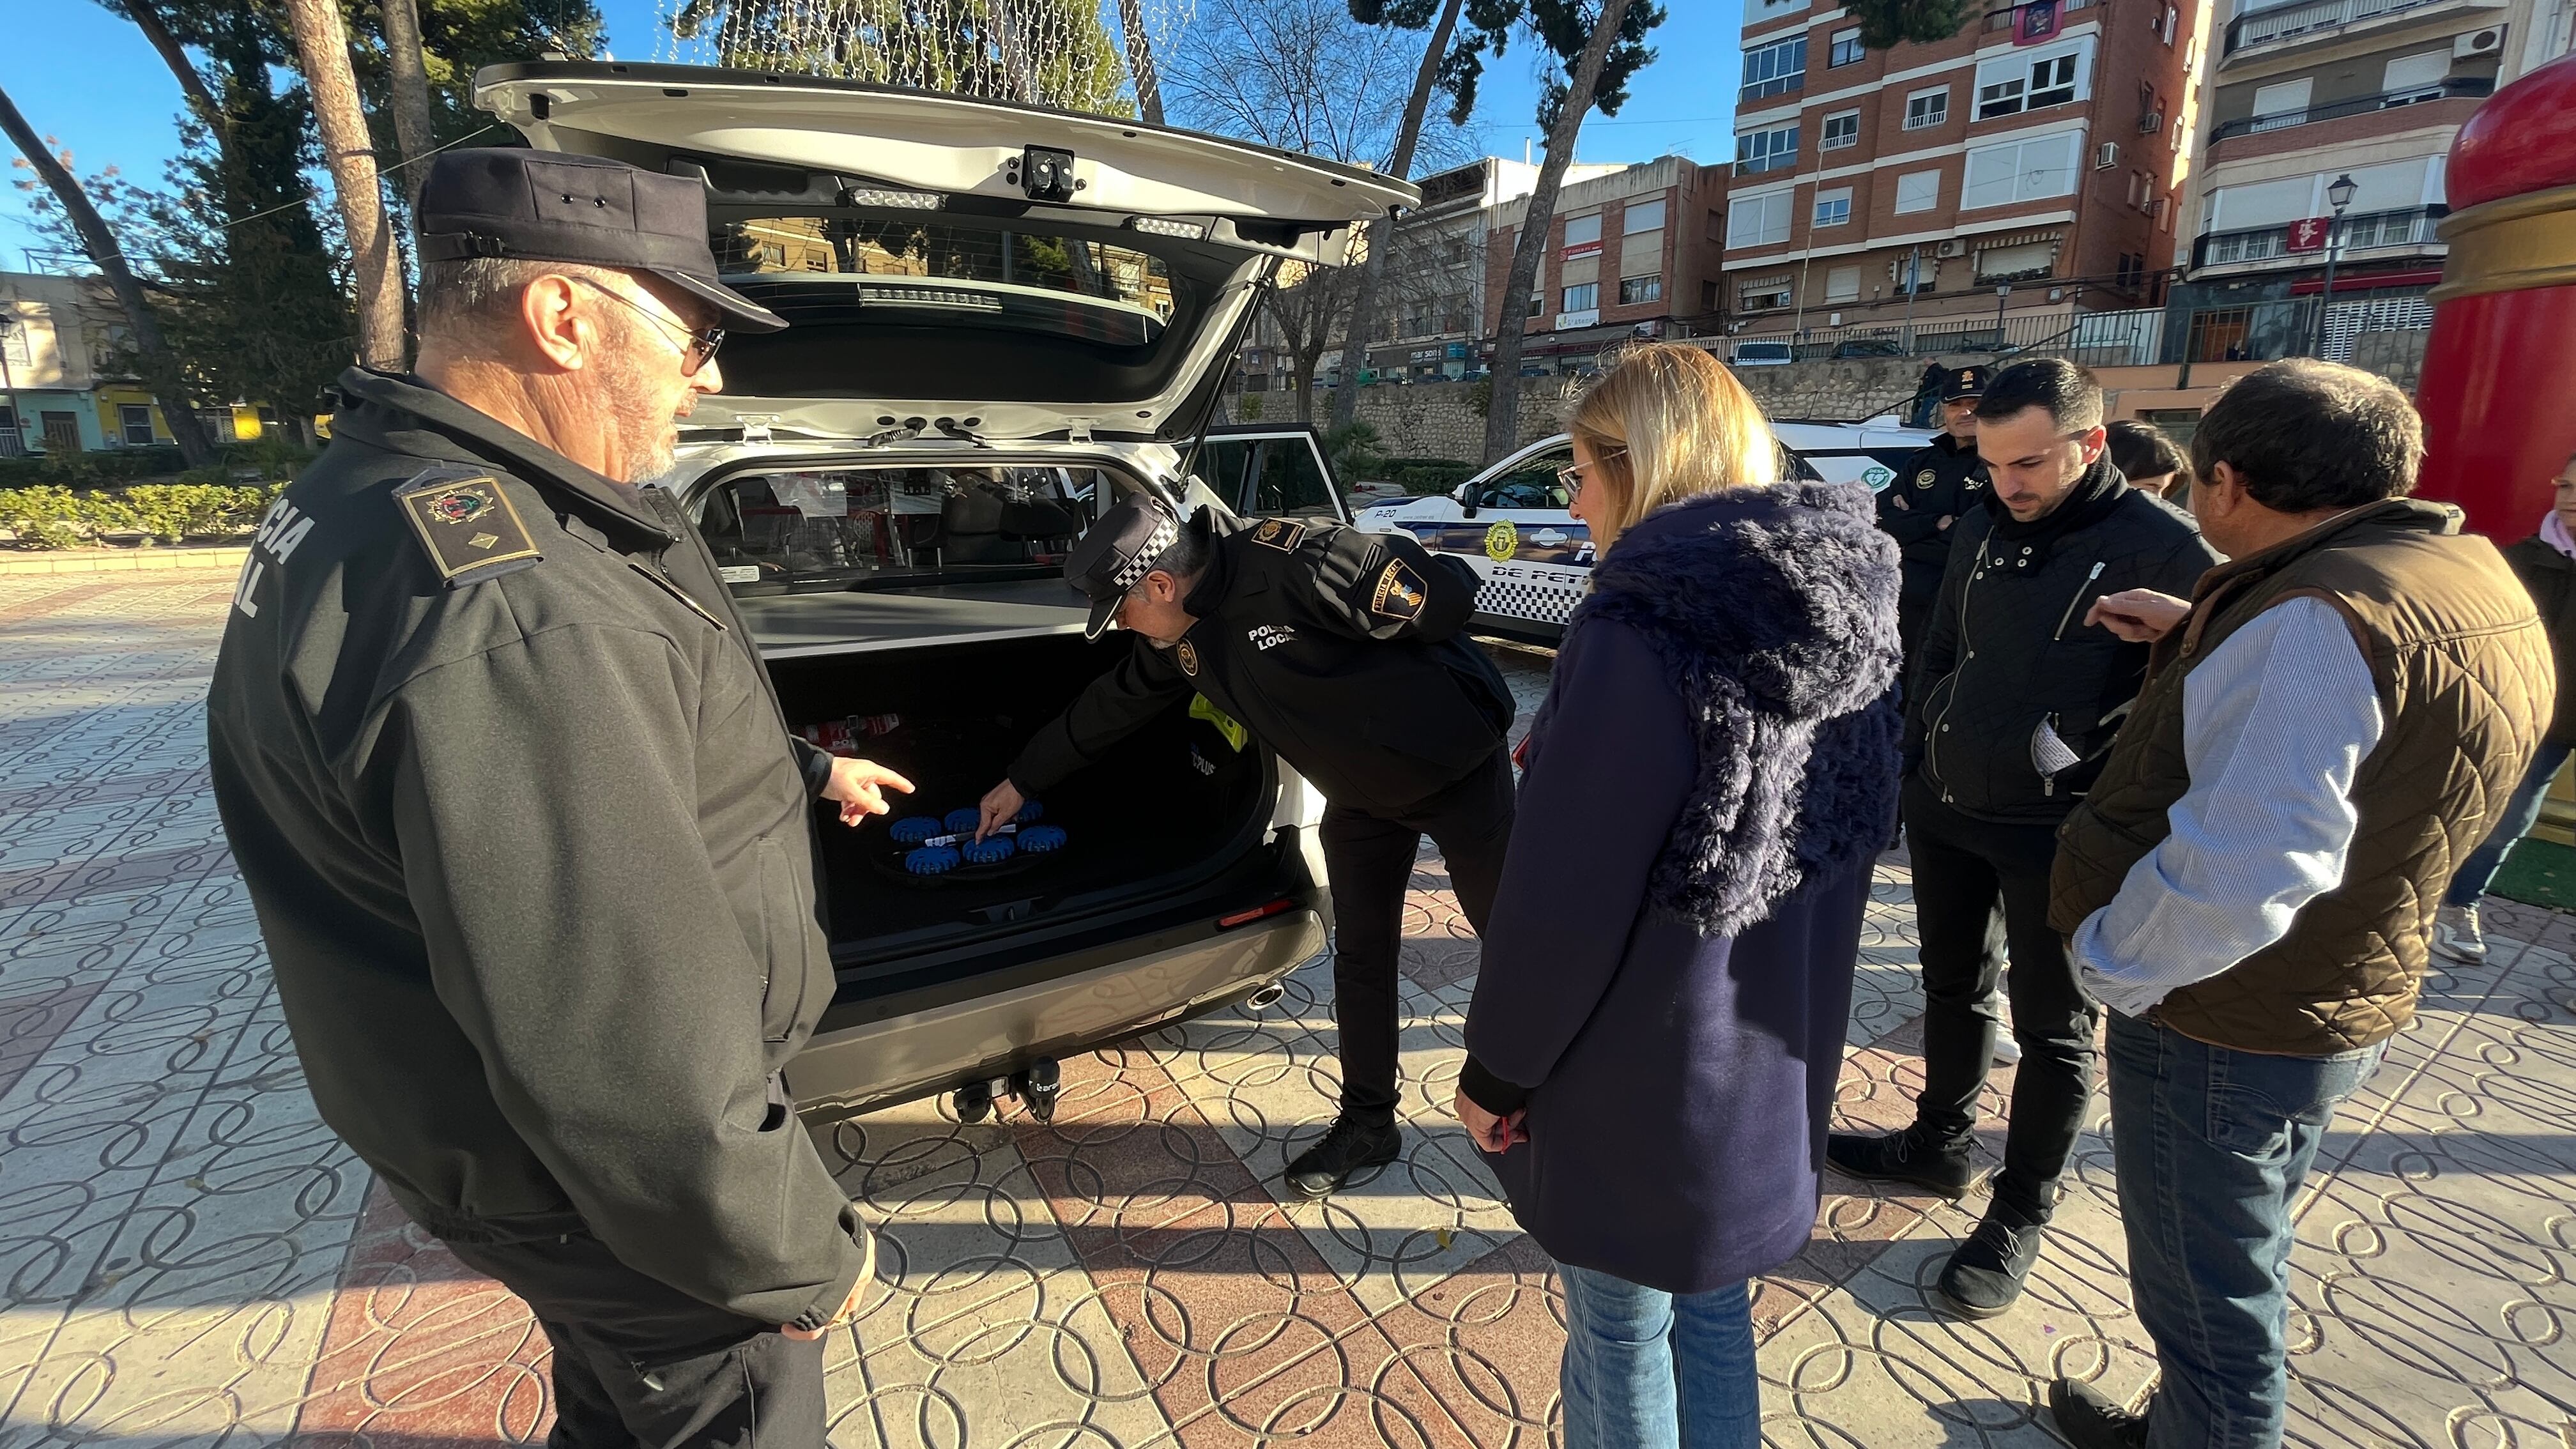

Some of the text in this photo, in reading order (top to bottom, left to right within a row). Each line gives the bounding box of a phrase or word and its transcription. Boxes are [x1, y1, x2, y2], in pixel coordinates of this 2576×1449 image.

[1374, 509, 1397, 518] P-20
[257, 494, 315, 565] CIA
[1492, 566, 1523, 578] DE
